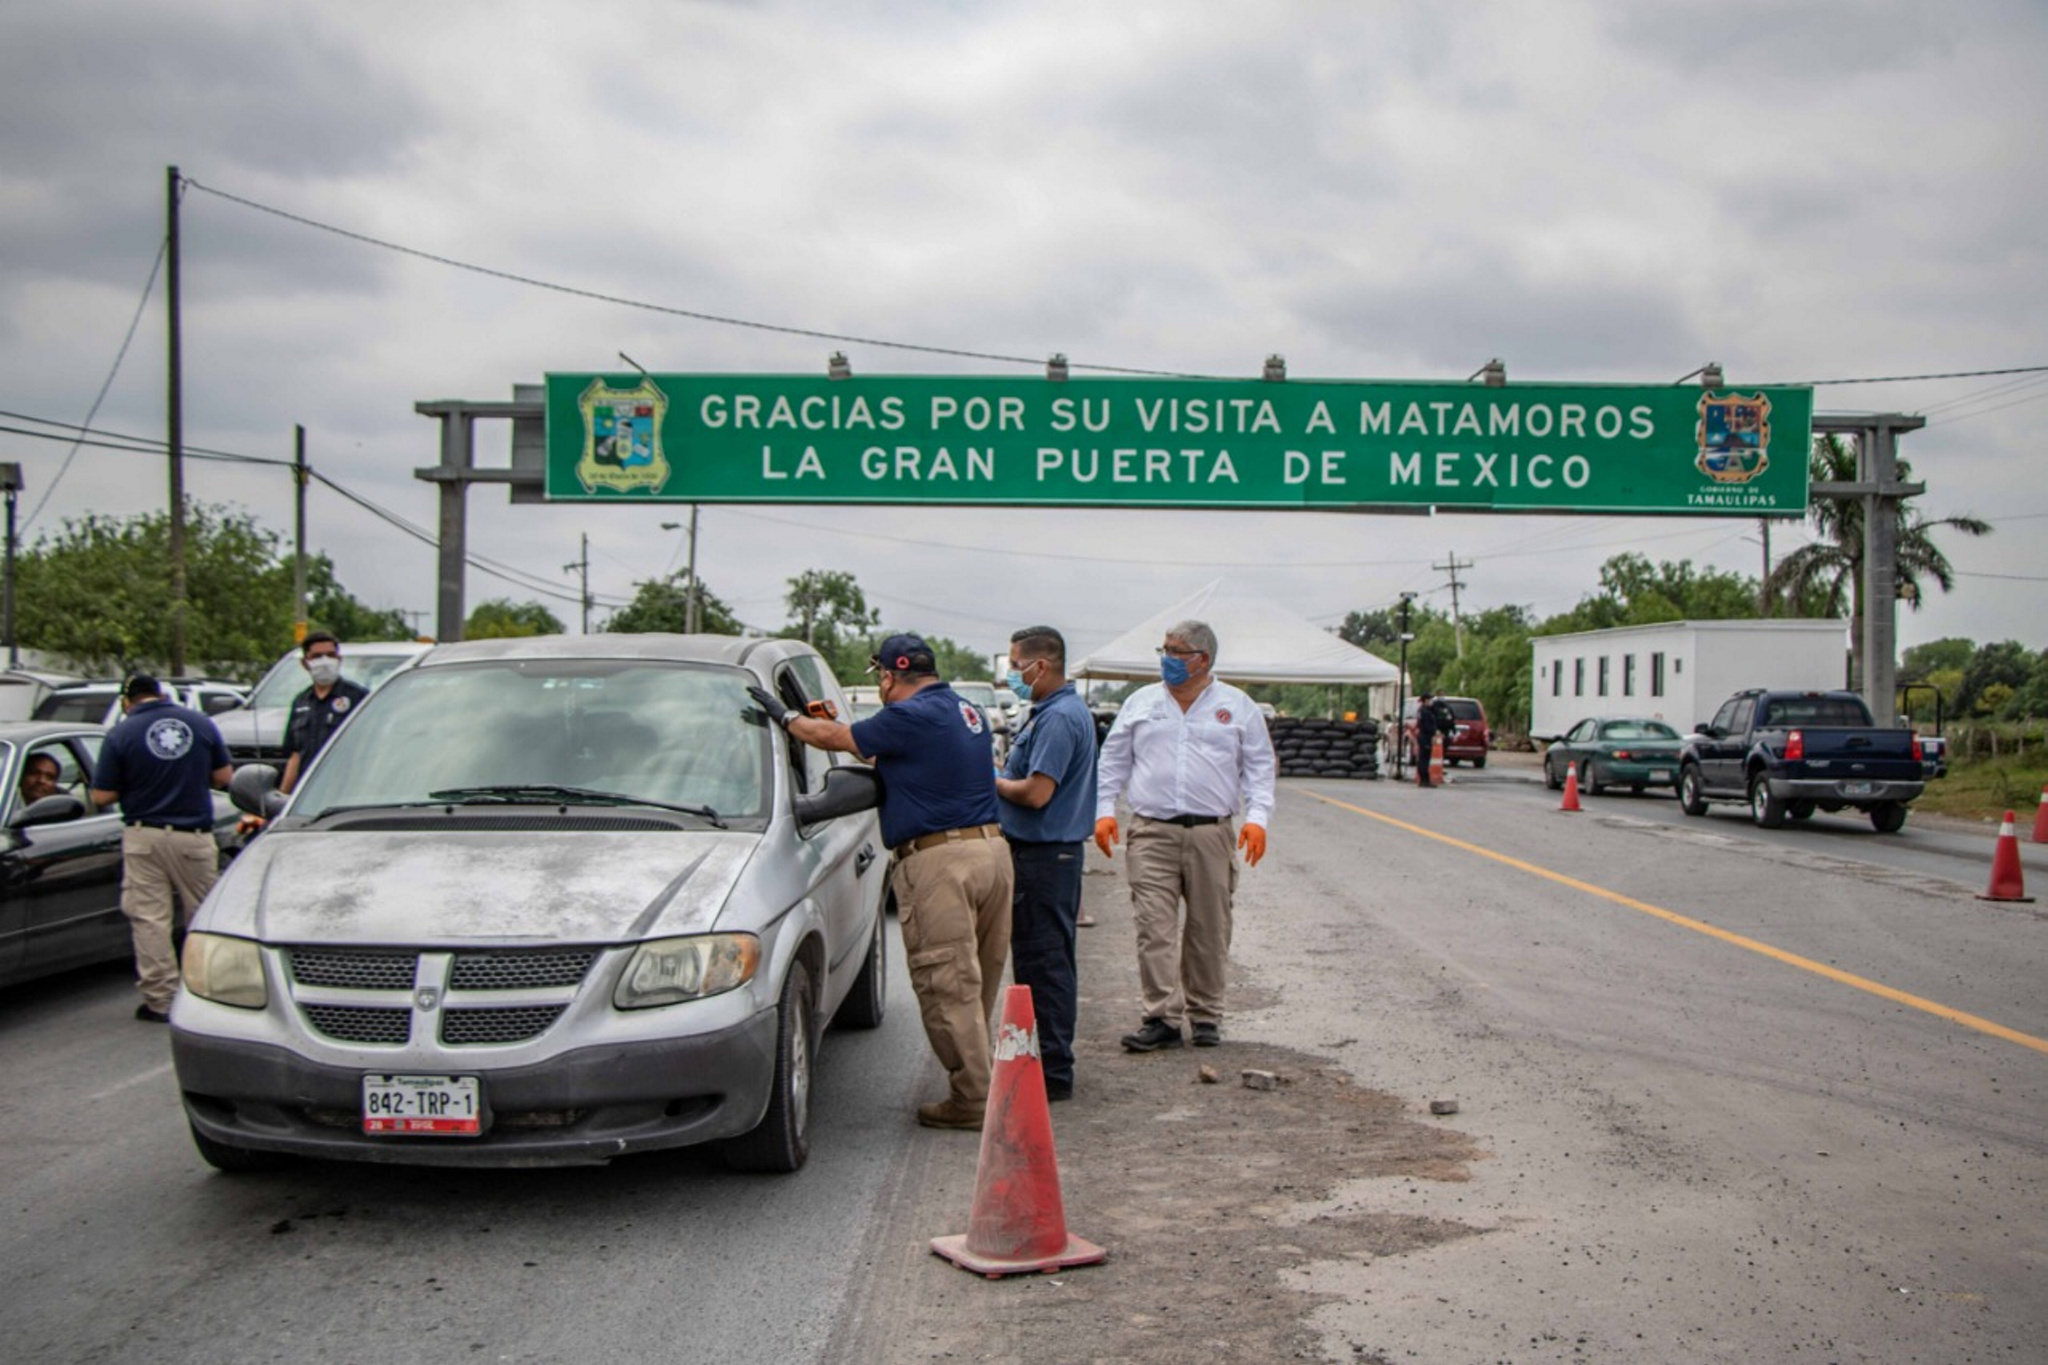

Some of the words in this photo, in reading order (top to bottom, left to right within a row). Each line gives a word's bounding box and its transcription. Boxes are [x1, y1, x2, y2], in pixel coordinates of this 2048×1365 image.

[701, 395, 905, 430] GRACIAS
[931, 396, 1025, 430] POR
[1051, 398, 1110, 432] SU
[1136, 398, 1281, 433] VISITA
[1306, 401, 1335, 433] A
[1360, 401, 1655, 439] MATAMOROS
[763, 446, 825, 479] LA
[861, 446, 994, 480] GRAN
[1037, 448, 1239, 483] PUERTA
[1284, 451, 1346, 484] DE
[1390, 452, 1590, 488] MEXICO
[1687, 493, 1777, 507] TAMAULIPAS
[368, 1091, 473, 1115] 842-TRP-1
